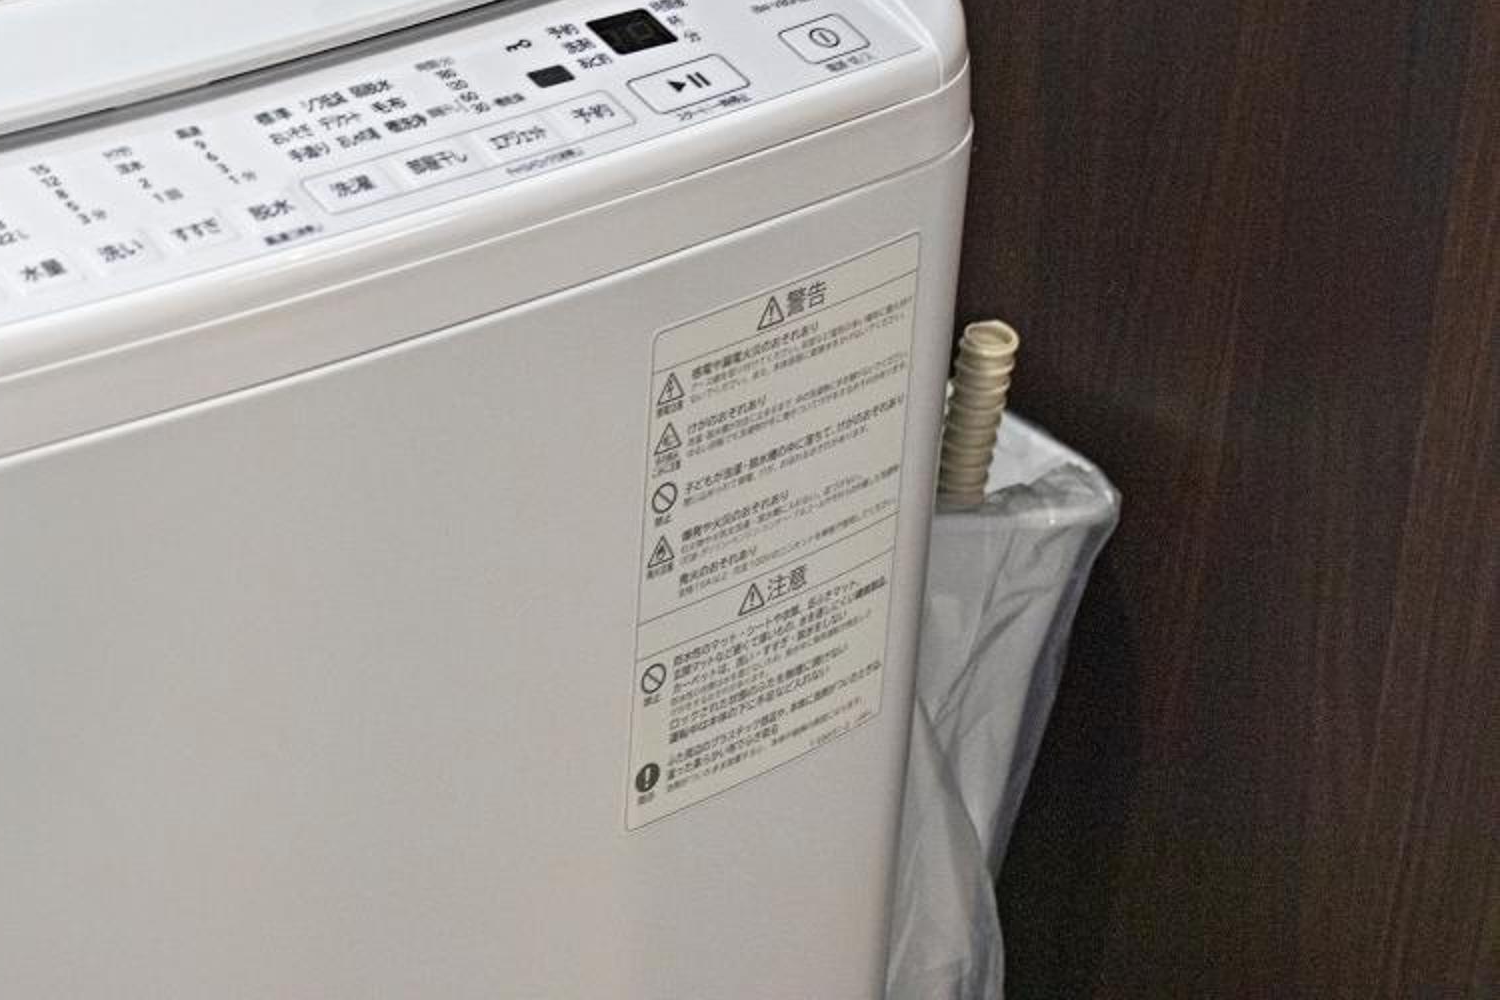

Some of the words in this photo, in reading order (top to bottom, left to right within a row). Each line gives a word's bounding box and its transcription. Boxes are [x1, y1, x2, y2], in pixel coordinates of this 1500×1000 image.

[254, 107, 292, 126] 標準
[571, 103, 616, 124] 予約
[405, 150, 468, 175] 部屋干し
[330, 174, 377, 198] 洗濯
[248, 199, 297, 221] 脱水
[170, 217, 222, 242] すすぎ
[98, 238, 145, 264] 洗い
[20, 258, 68, 282] 水量
[786, 281, 827, 318] 警告
[766, 565, 808, 602] 注意
